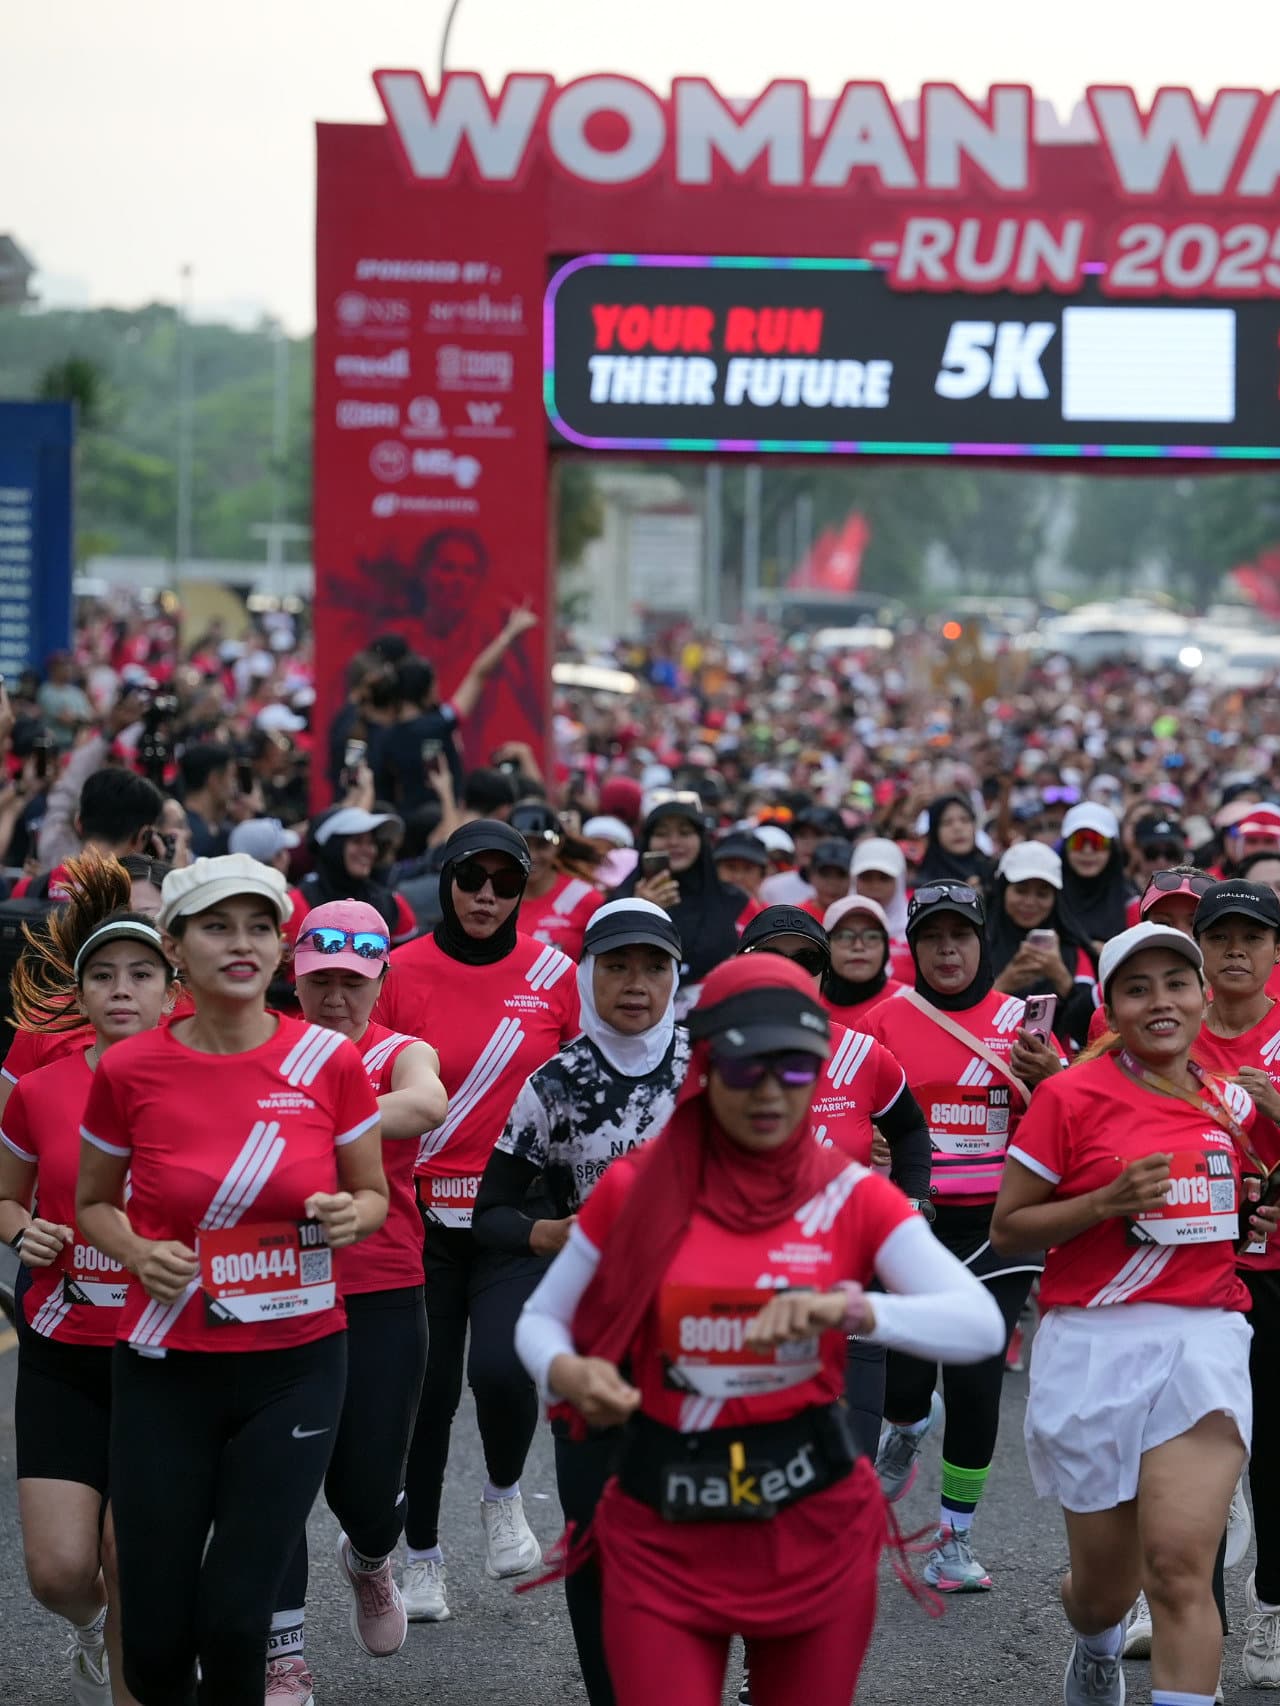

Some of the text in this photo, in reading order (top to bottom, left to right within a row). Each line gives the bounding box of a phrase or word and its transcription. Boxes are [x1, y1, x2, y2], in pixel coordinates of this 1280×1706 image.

[376, 68, 1030, 191] WOMAN
[591, 303, 824, 354] YOUR RUN
[934, 319, 1056, 400] 5K
[588, 354, 893, 409] THEIR FUTURE
[1215, 892, 1260, 902] CHALLENGE
[930, 1102, 987, 1126] 850010
[989, 1088, 1009, 1105] 10K
[576, 1163, 608, 1179] SPO
[1206, 1154, 1232, 1176] 10K
[1165, 1175, 1210, 1207] 0013
[210, 1247, 297, 1285] 800444
[667, 1441, 815, 1507] naked
